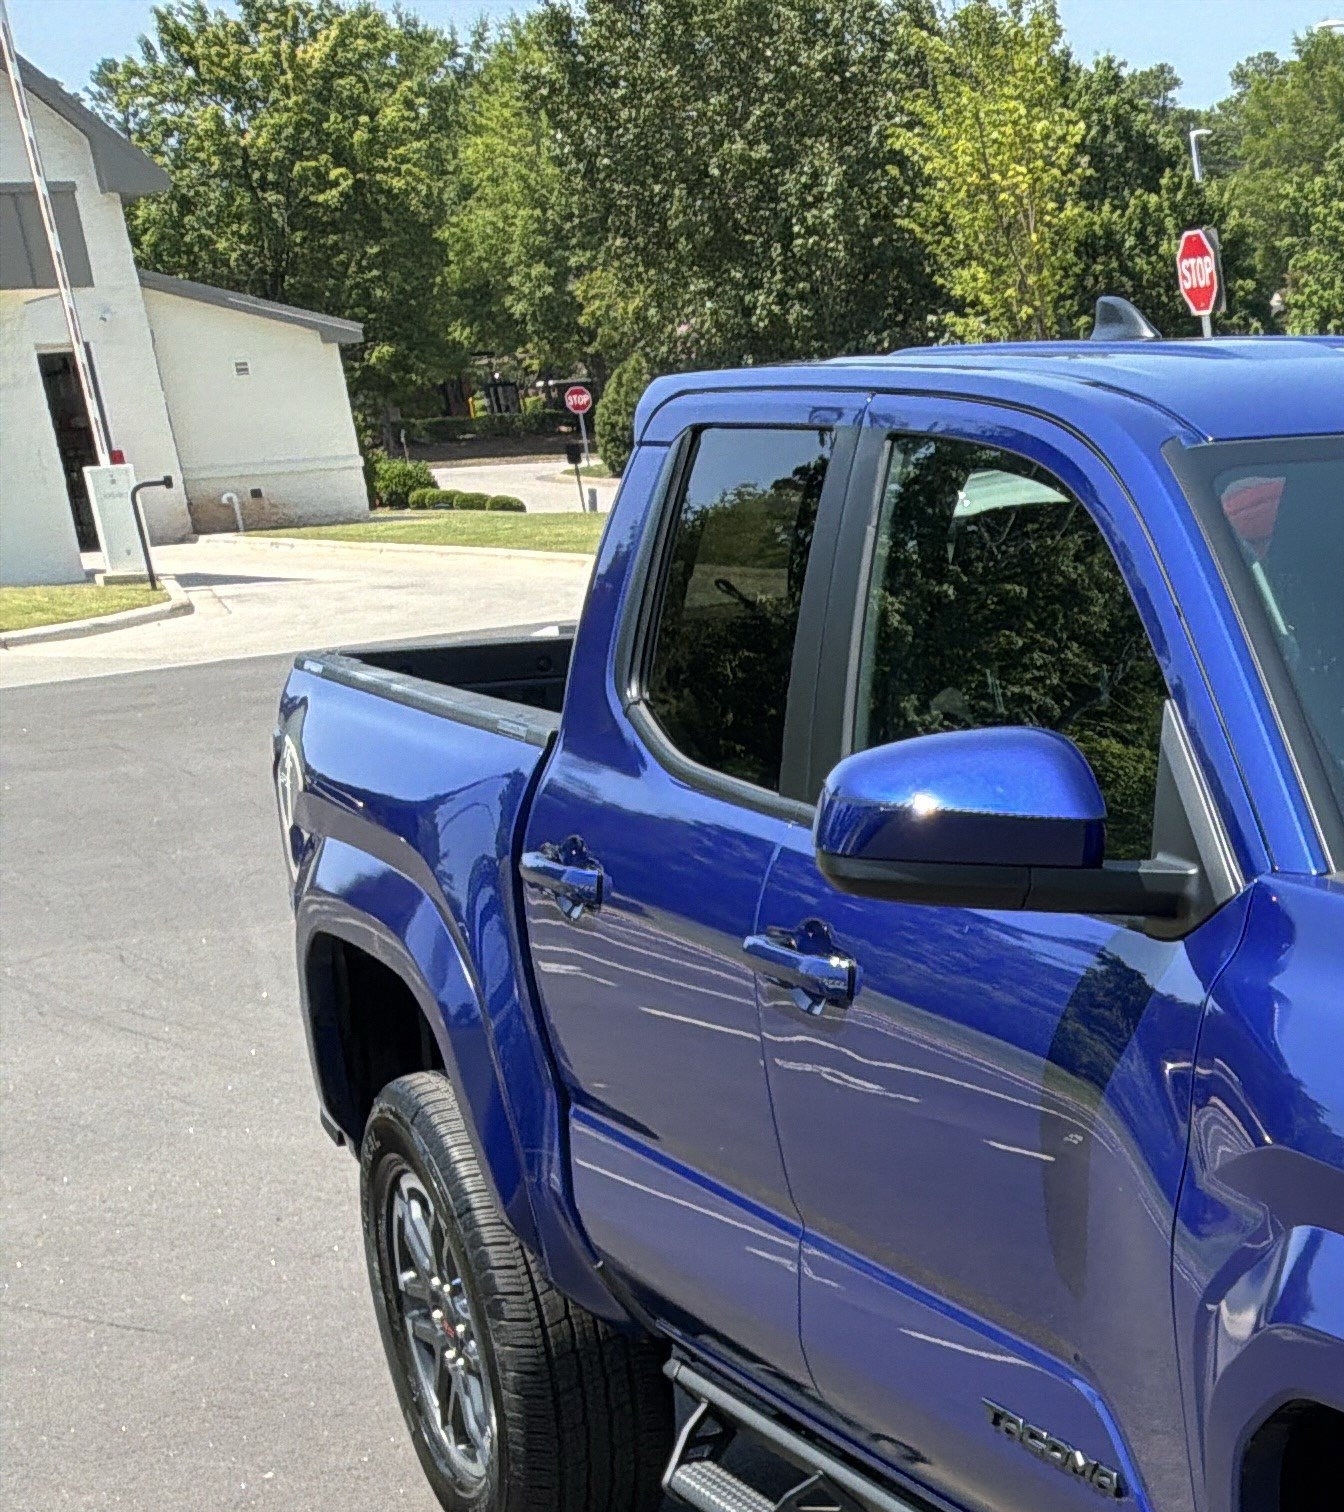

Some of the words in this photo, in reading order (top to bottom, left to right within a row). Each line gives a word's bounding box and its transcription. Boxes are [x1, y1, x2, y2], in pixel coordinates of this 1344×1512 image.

[1181, 255, 1214, 290] STOP
[566, 393, 591, 406] STOP
[981, 1396, 1124, 1500] TACOMA
